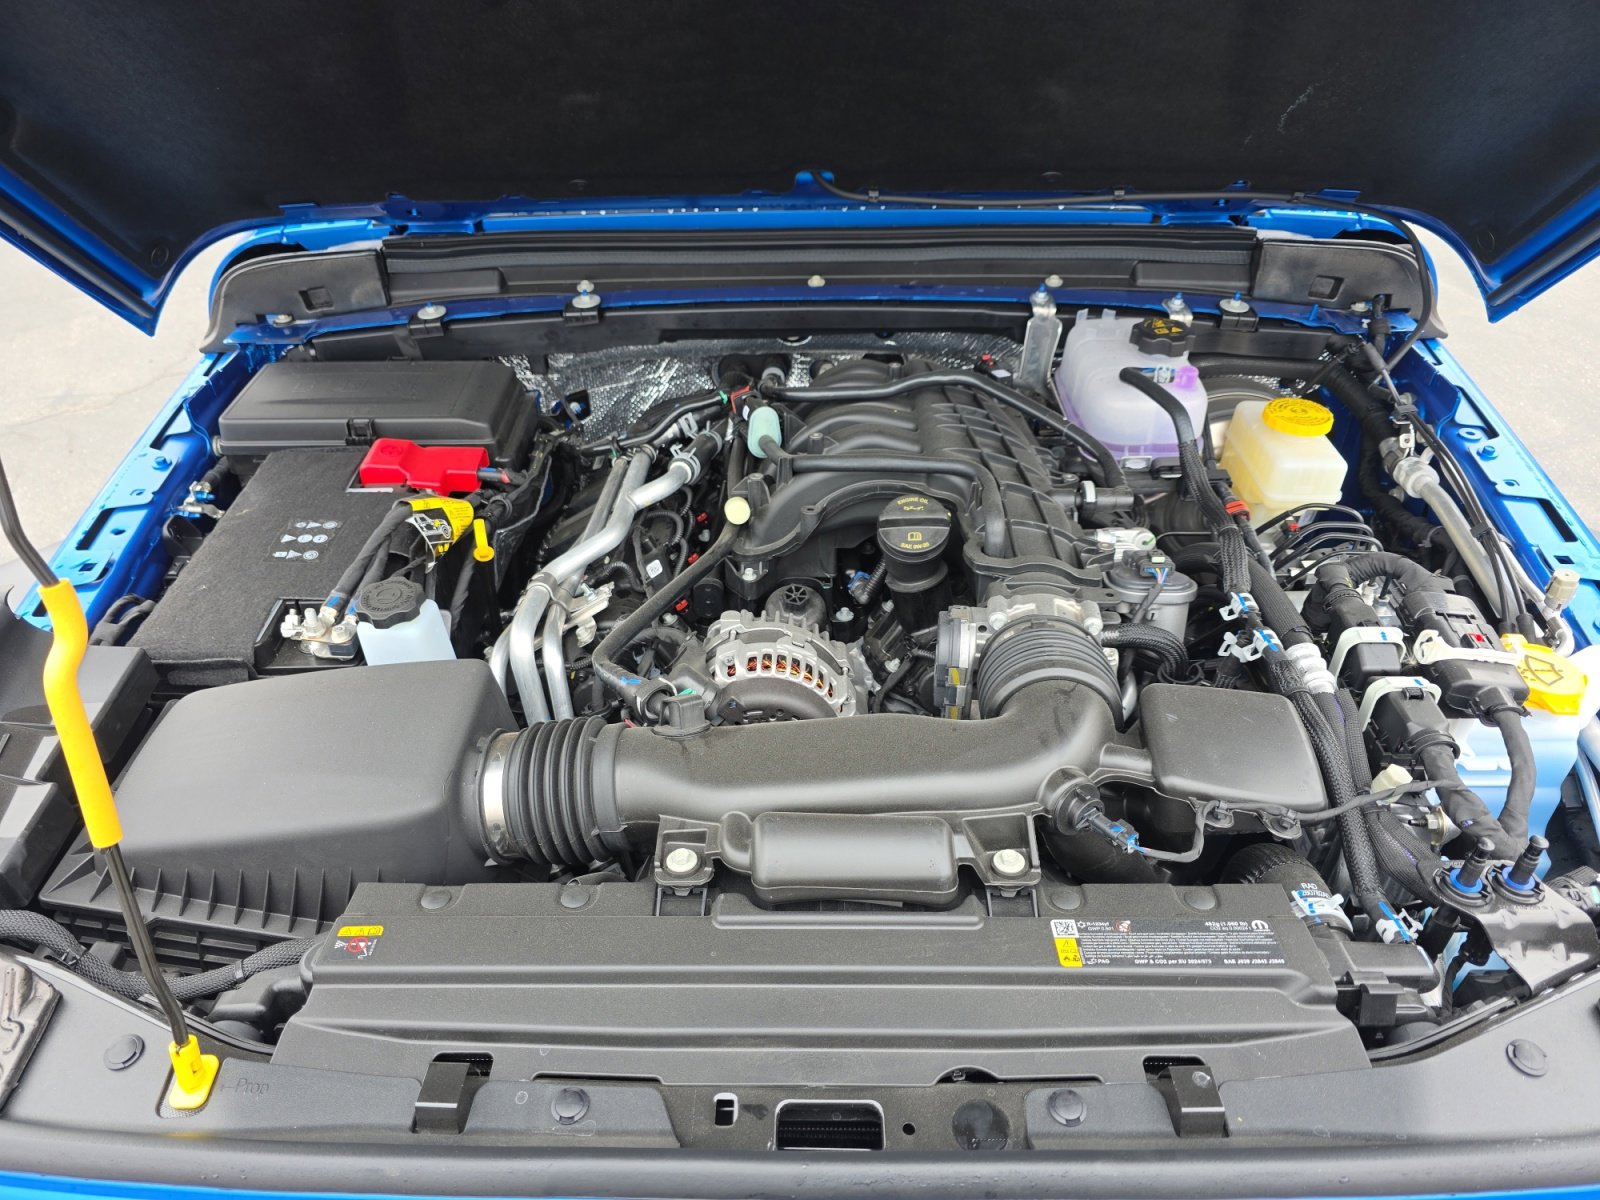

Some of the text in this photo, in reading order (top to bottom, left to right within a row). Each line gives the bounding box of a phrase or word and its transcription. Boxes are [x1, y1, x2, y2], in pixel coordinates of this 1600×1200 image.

[897, 497, 928, 505] ENGINE OIL
[1300, 882, 1318, 890] RAD
